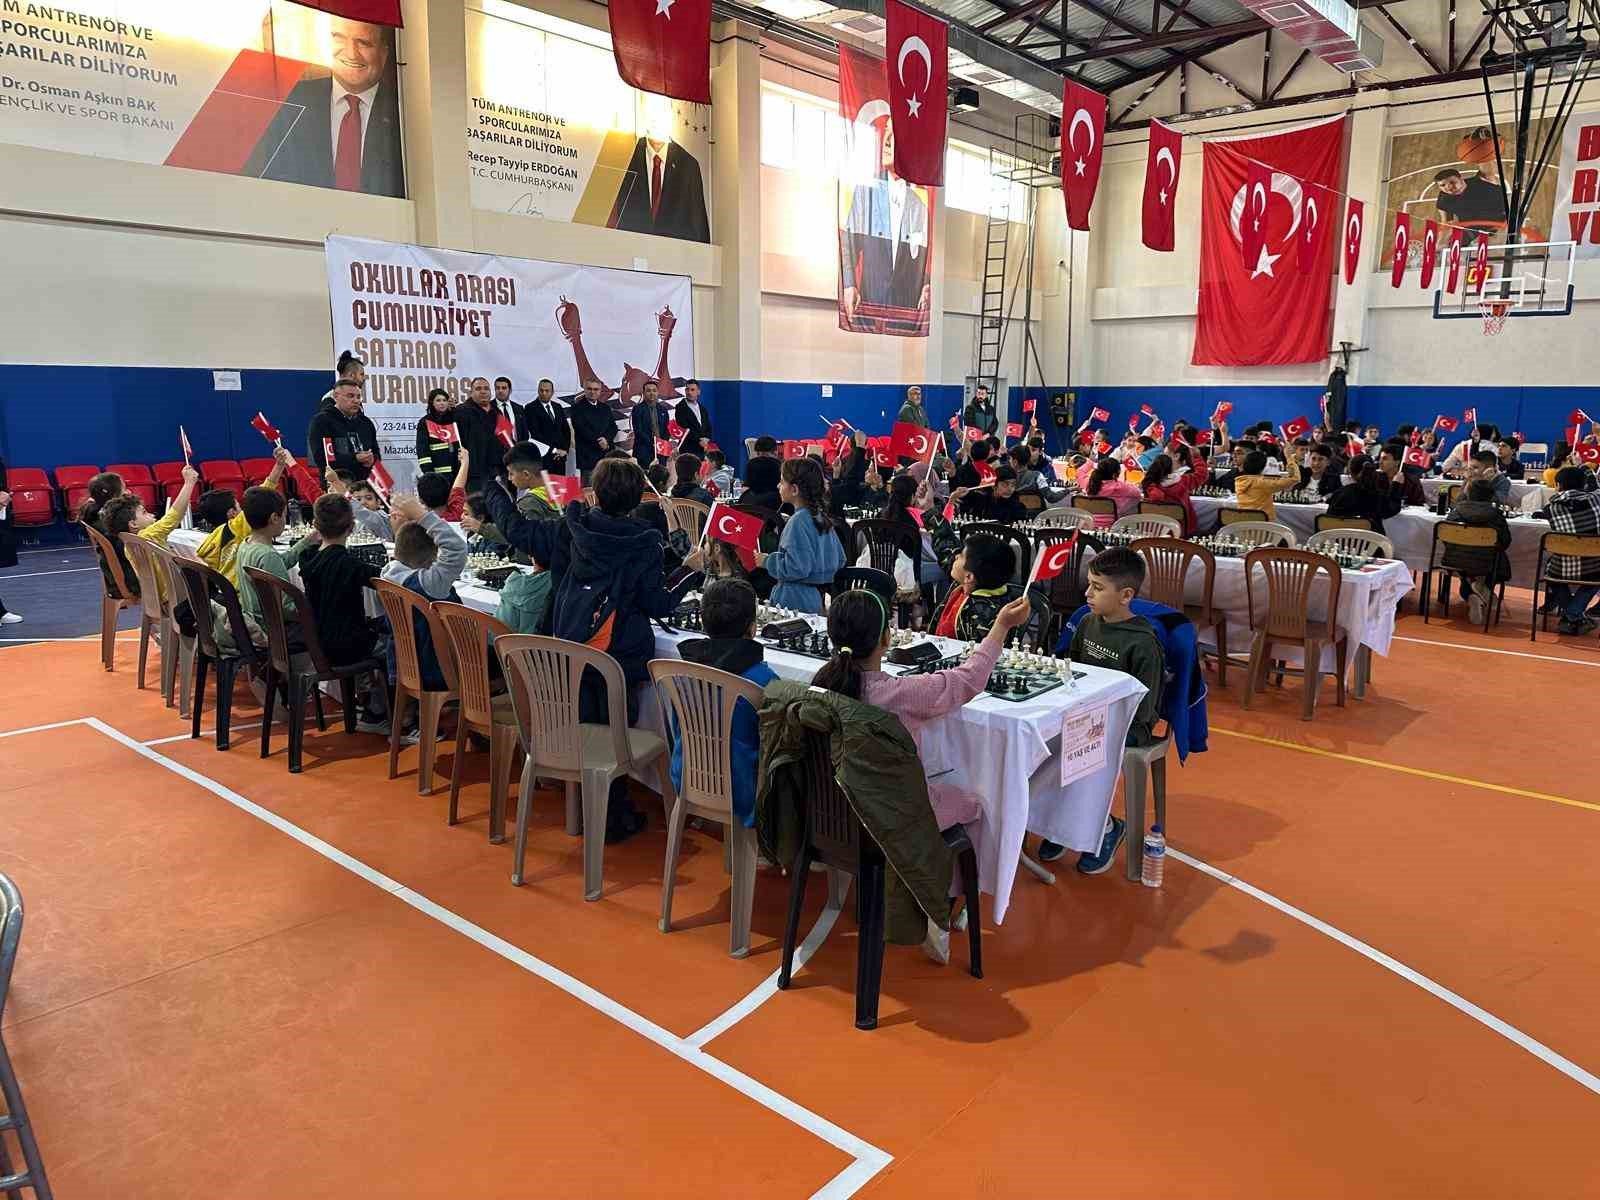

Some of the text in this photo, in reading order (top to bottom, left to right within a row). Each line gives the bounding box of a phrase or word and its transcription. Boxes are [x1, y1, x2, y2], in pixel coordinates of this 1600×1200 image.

[26, 3, 128, 35] ANTRENÖR
[131, 25, 153, 41] VE
[2, 20, 148, 60] PORCULARIMIZA
[80, 55, 178, 86] DİLİYORUM
[2, 76, 157, 112] Dr. Osman Aşkın BAK
[57, 103, 77, 116] VE
[80, 107, 119, 122] SPOR
[122, 113, 174, 131] BAKANI
[472, 97, 496, 112] TÜM
[553, 115, 566, 127] VE
[479, 115, 562, 140] SPORCULARIMIZA
[525, 138, 578, 159] DİLİYORUM
[467, 150, 578, 179] Recep Tayyip ERDOĞAN
[471, 167, 574, 192] T.C. CUMHURBAŞKANI
[350, 261, 516, 306] OKULLAR ARASI
[352, 300, 492, 338] CUMHURİYET
[354, 337, 457, 374] SATRANÇ
[382, 422, 406, 431] 23-24
